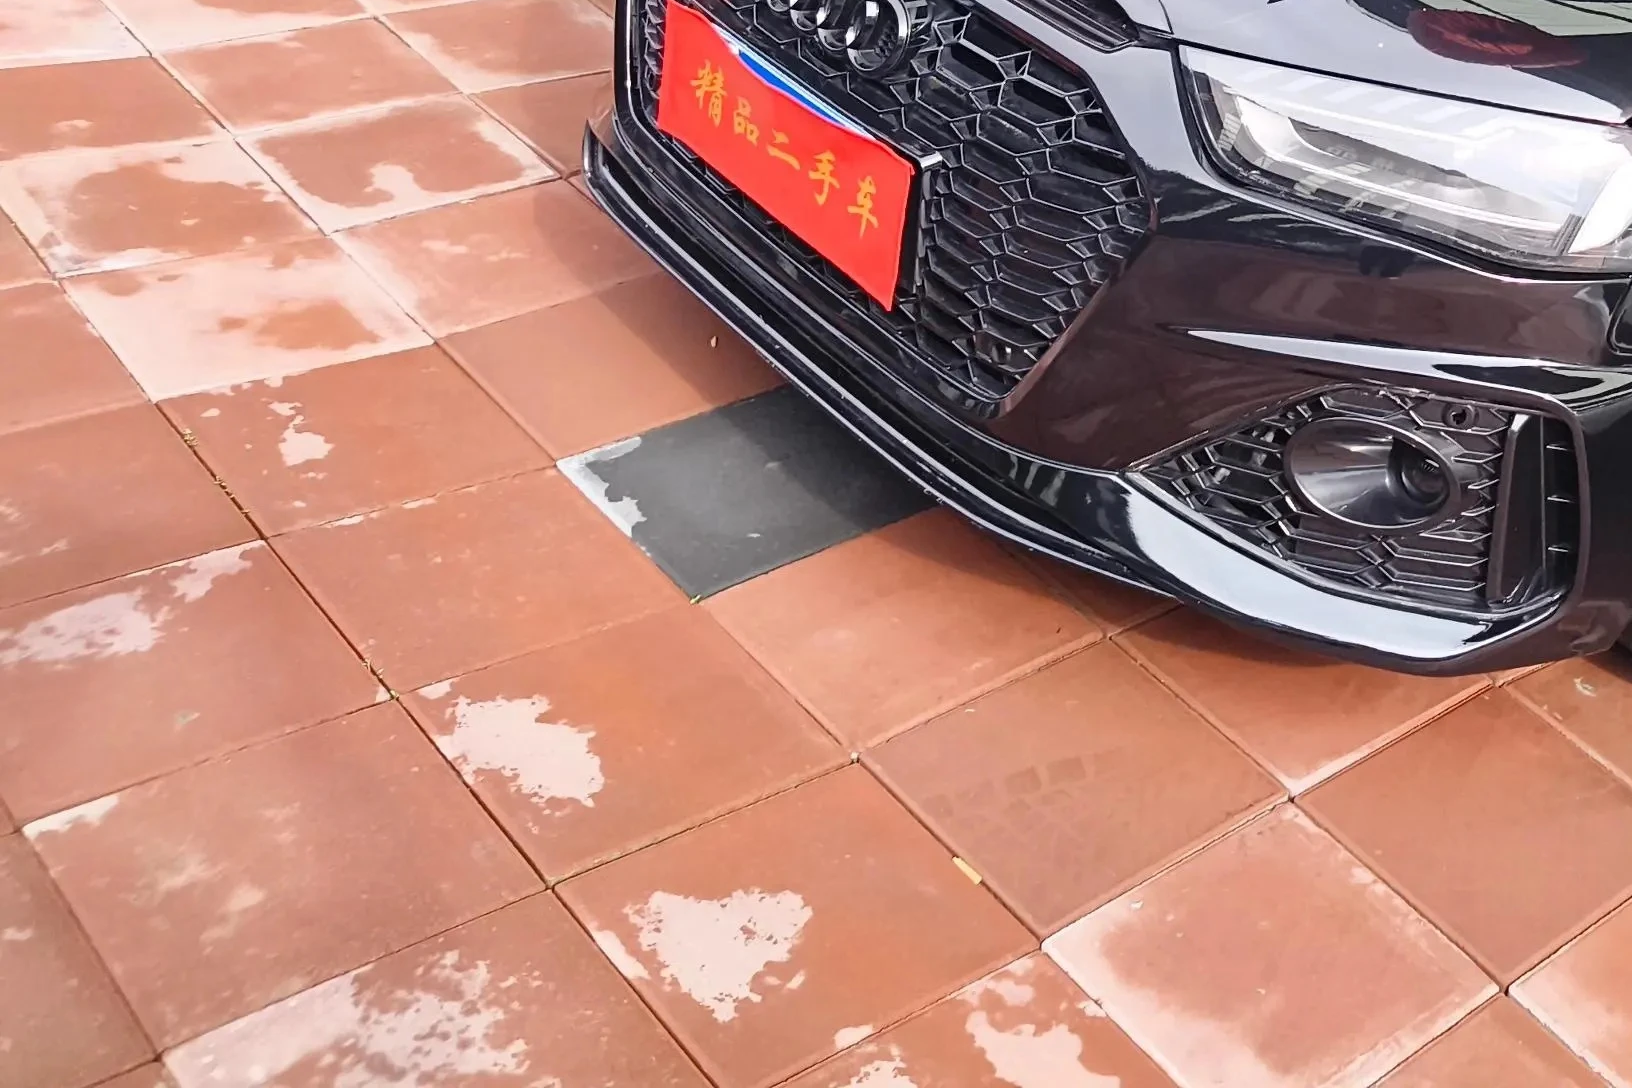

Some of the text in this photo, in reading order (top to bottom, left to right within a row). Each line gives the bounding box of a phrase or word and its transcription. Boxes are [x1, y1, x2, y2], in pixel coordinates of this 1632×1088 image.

[689, 59, 879, 239] 精品二手车
